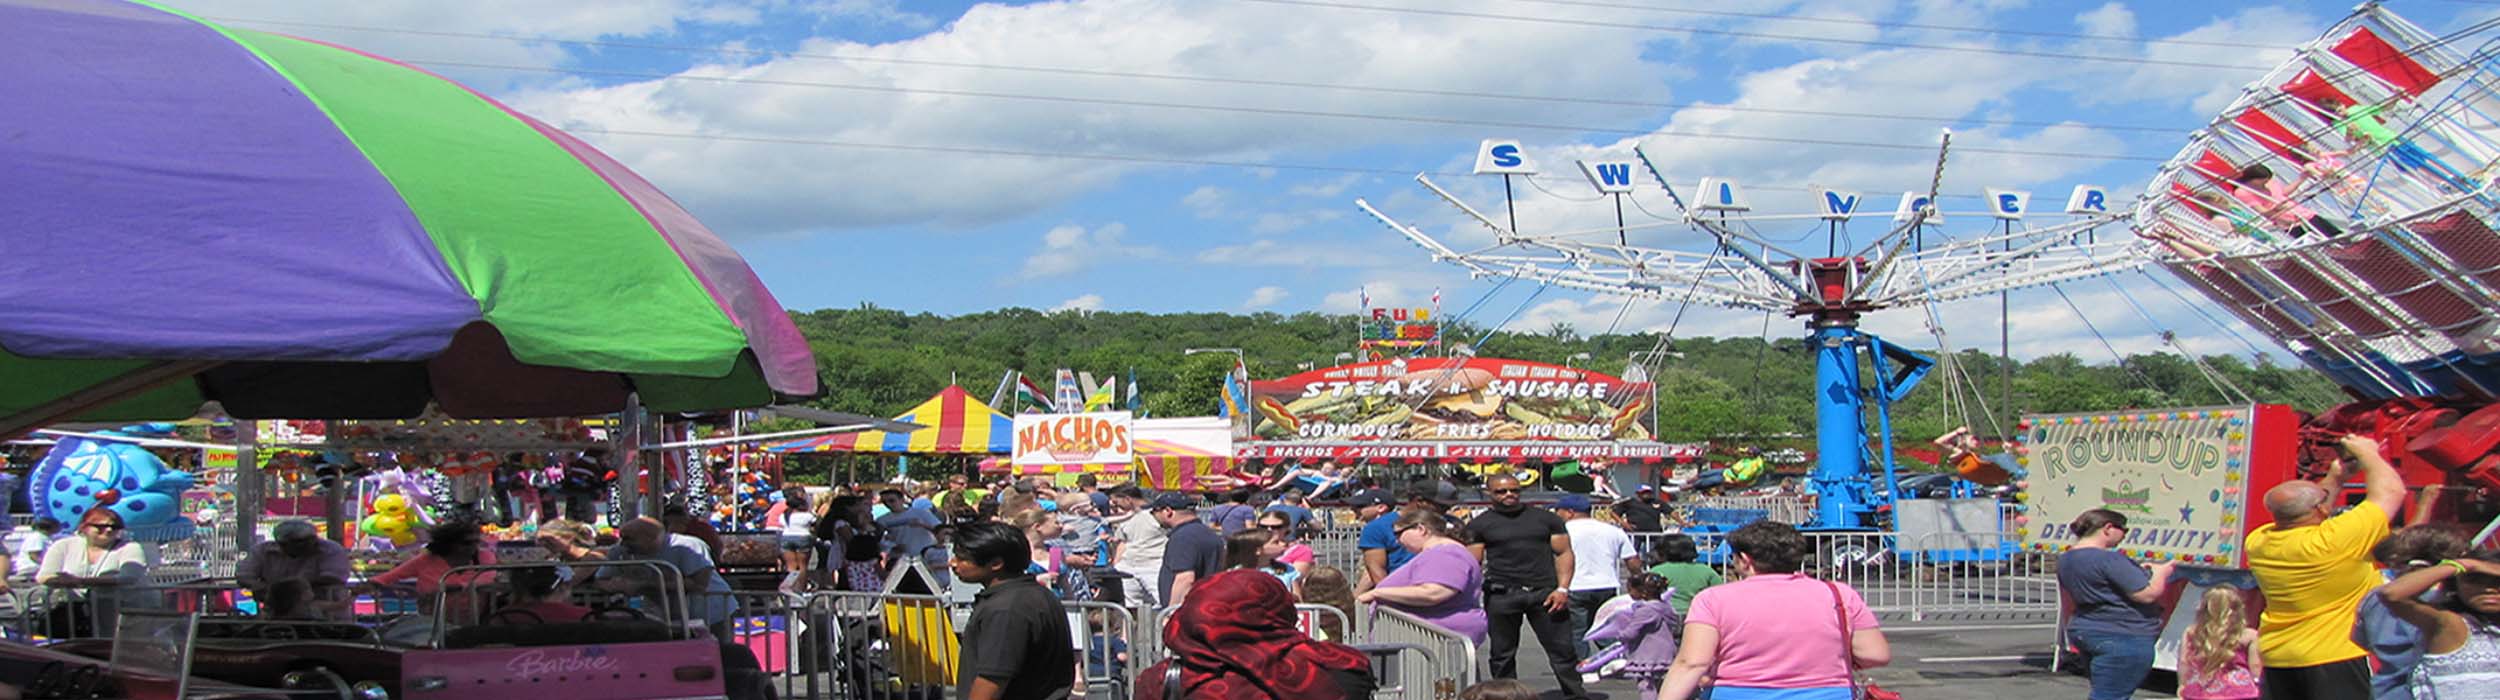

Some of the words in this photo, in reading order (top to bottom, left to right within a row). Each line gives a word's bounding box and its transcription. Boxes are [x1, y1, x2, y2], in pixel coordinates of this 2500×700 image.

[1372, 307, 1431, 321] FUN
[1302, 380, 1433, 398] STEAK
[1485, 379, 1608, 398] SAUSAGE
[1017, 416, 1128, 458] NACHOS
[1299, 423, 1402, 437] CORNDOGS
[1436, 423, 1492, 437] FRIES
[1527, 423, 1612, 437] HOTDOGS
[1273, 446, 1334, 457] NACHOS
[1464, 446, 1510, 457] STEAK
[1521, 446, 1564, 457] ONION
[2042, 430, 2220, 479] ROUNDUP
[2125, 527, 2214, 549] RAVITY
[506, 649, 617, 679] Barbie
